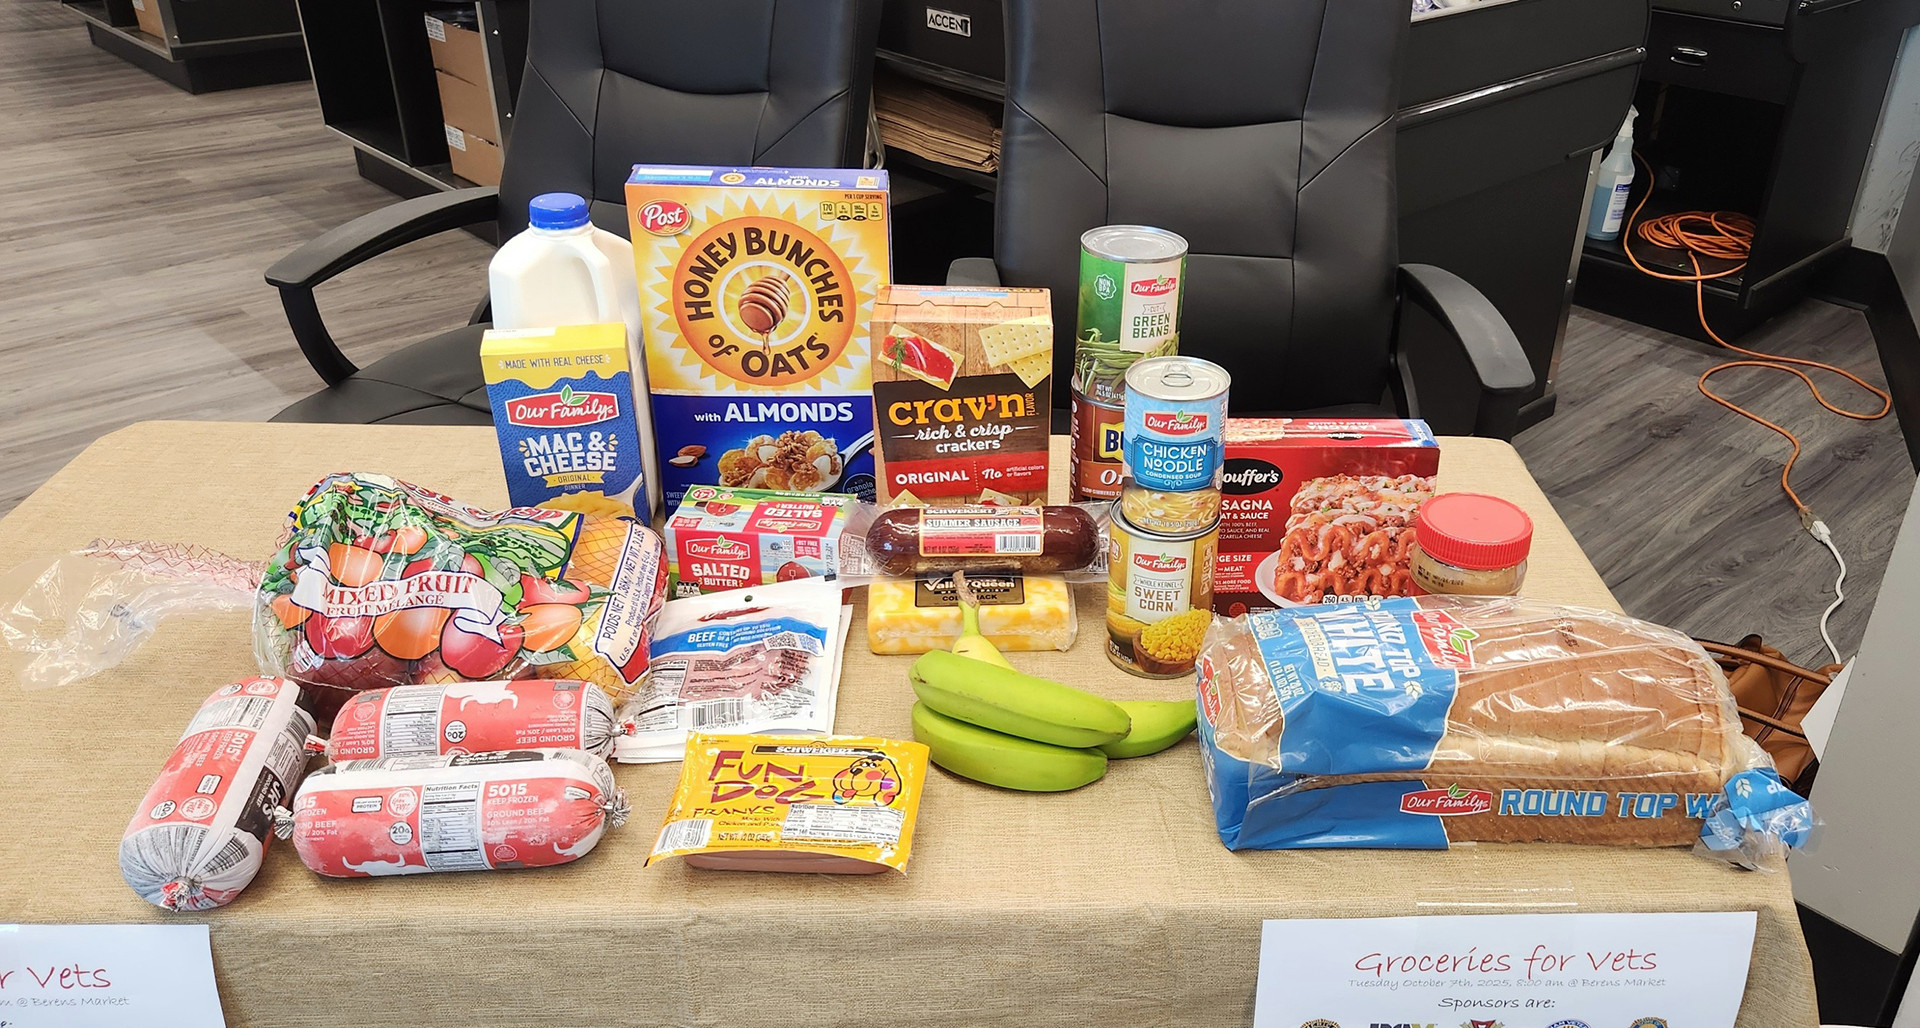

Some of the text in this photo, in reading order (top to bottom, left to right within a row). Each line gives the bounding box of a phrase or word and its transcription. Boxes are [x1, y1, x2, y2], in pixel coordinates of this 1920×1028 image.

[928, 13, 970, 34] ACCENT
[755, 177, 840, 187] ALMONDS
[643, 205, 684, 229] Post
[684, 227, 844, 324] HONEY BUNCHES
[1133, 283, 1150, 292] Our
[1133, 313, 1171, 327] GREEN
[1132, 325, 1169, 338] BEANS
[505, 354, 604, 369] MADE WITH REAL CHEESE
[708, 334, 830, 378] of OATS
[515, 398, 611, 421] Our Family
[694, 402, 854, 422] with ALMONDS
[888, 393, 1035, 426] crav'n FLAVOR
[1147, 415, 1206, 433] Our Family
[914, 424, 1013, 441] rich & crisp
[526, 431, 607, 457] MAC &
[935, 439, 1001, 453] crackers
[1143, 442, 1207, 459] CHICKEN
[523, 452, 618, 477] CHEESE
[1144, 458, 1203, 473] NOODLE
[557, 473, 591, 482] ORIGINAL
[896, 469, 970, 485] ORIGINAL
[982, 468, 1003, 480] No
[1146, 470, 1184, 479] CONDENSED
[1222, 468, 1280, 486] ouffer's
[564, 483, 586, 491] DINNER
[764, 507, 824, 518] SALTED
[1221, 499, 1273, 511] SAGNA
[926, 518, 1020, 528] SUMMER SAUSAGE
[633, 528, 645, 543] LBS
[632, 540, 642, 548] 3
[691, 542, 746, 558] Our Family
[629, 546, 640, 558] WT.
[624, 557, 637, 574] NET
[1135, 555, 1185, 571] Our Family
[691, 563, 750, 580] SALTED
[322, 574, 478, 605] MIXED FRUIT
[704, 578, 739, 588] BUTTER
[971, 579, 1015, 589] Queen
[1139, 577, 1178, 588] WHOLE KERNEL
[682, 586, 695, 595] AA
[1134, 586, 1181, 601] SWEET
[612, 597, 625, 614] NET
[1139, 600, 1174, 612] CORN
[1324, 596, 1336, 604] 260
[326, 604, 372, 616] FRUIT
[625, 605, 638, 626] Product
[602, 612, 621, 640] POIDS
[687, 631, 717, 643] BEEF
[619, 646, 631, 661] U.S.
[1315, 606, 1395, 694] WHITE
[1386, 646, 1422, 678] TOP
[226, 732, 249, 756] 5015
[538, 735, 576, 743] GROUND
[340, 746, 375, 756] GROUND
[775, 745, 855, 756] SCHWEIGERT
[708, 751, 804, 783] FUN
[425, 785, 457, 794] Nutrition
[488, 783, 528, 797] 5015
[711, 781, 825, 804] DOG
[262, 780, 281, 821] JR'S
[509, 796, 538, 804] FROZEN
[1407, 793, 1484, 813] Our Family
[1499, 788, 1608, 817] ROUND
[1616, 792, 1679, 818] TOP
[487, 808, 524, 818] GROUND
[693, 806, 775, 818] FRANKS
[315, 820, 337, 828] BEEF
[717, 833, 729, 841] NET
[1354, 944, 1658, 980] Groceries for Vets
[26, 963, 112, 990] Vets
[1348, 978, 1668, 991] Tuesday October 7th, 2025, 8:00 am @ Berens Market
[16, 996, 131, 1008] @ Berens Market
[1438, 997, 1556, 1012] Sponsors are:
